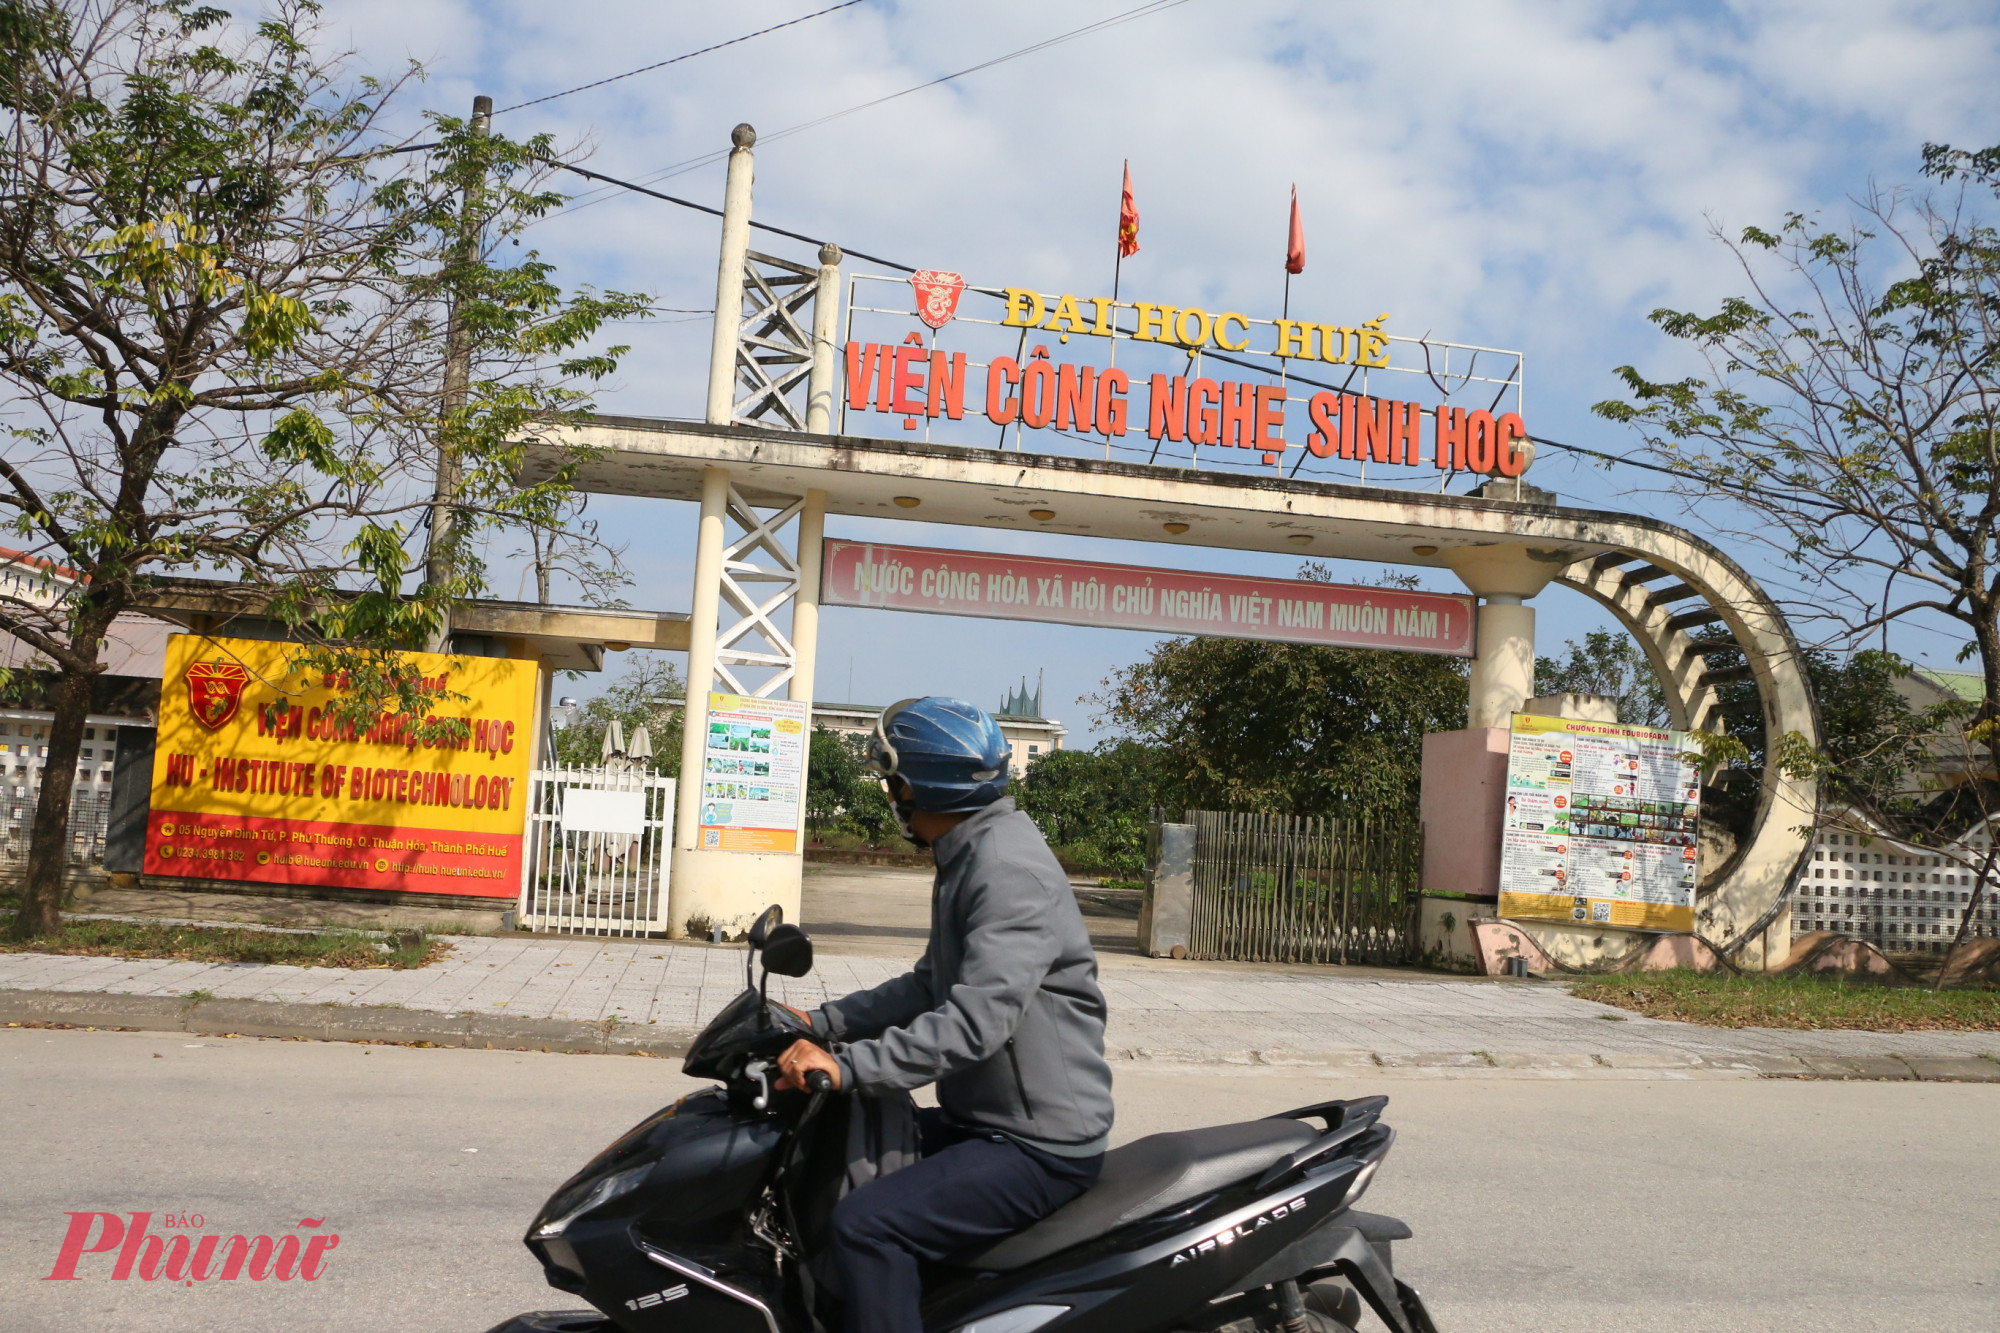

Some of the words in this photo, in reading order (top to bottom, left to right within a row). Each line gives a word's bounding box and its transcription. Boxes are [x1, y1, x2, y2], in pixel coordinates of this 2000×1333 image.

[1001, 287, 1113, 344] ĐẠI
[1132, 302, 1250, 358] HỌC
[1273, 312, 1391, 368] HUẾ
[846, 332, 966, 430] VIỆN
[986, 345, 1129, 437] CÔNG
[1148, 373, 1287, 465] NGHỆ
[1307, 391, 1420, 467] SINH
[853, 560, 914, 595] NƯỚC
[920, 564, 980, 604] CỘNG
[986, 569, 1029, 604] HÒA
[1036, 574, 1064, 608] XÃ
[1071, 577, 1105, 617] HỘI
[1112, 577, 1154, 615] CHỦ
[1160, 587, 1222, 622] NGHĨA
[1228, 591, 1272, 630] VIỆT
[1277, 599, 1323, 630] NAM
[1329, 600, 1387, 635] MUÔN
[1393, 605, 1437, 639] NĂM
[1443, 613, 1450, 639] !
[474, 718, 515, 760] HỌC
[166, 753, 195, 787] HU
[213, 756, 317, 798] INSTITUTE
[320, 764, 347, 799] OF
[350, 766, 515, 811] BIOTECHNOLOGY
[431, 841, 463, 855] Thành
[625, 1283, 690, 1311] 125
